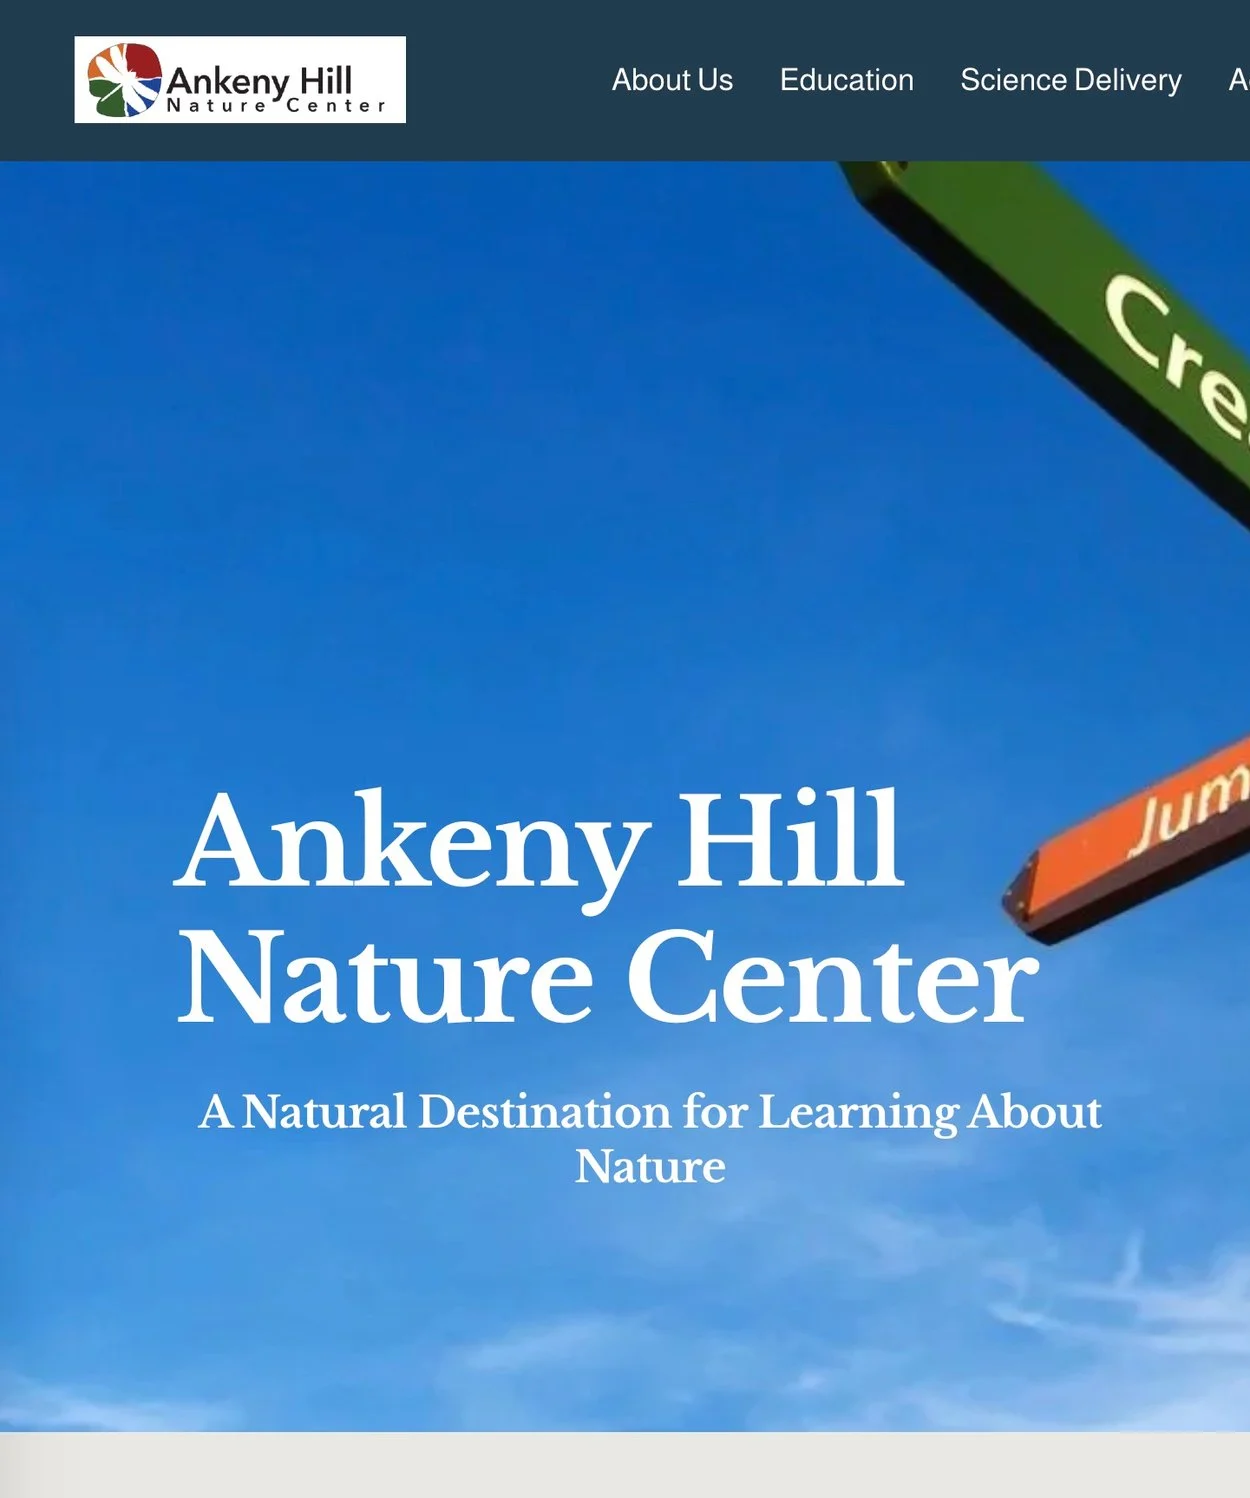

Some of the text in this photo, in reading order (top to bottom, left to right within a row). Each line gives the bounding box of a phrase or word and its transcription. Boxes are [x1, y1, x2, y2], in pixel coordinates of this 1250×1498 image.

[166, 65, 352, 103] Ankeny Hill
[611, 67, 734, 92] About Us
[781, 67, 914, 92] Education
[961, 67, 1183, 98] Science Delivery
[167, 97, 385, 113] Nature Center
[175, 788, 904, 915] Ankeny Hill
[180, 929, 1039, 1023] Nature Center
[200, 1091, 1101, 1138] A Natural Destination for Learning About
[577, 1149, 726, 1183] Nature
